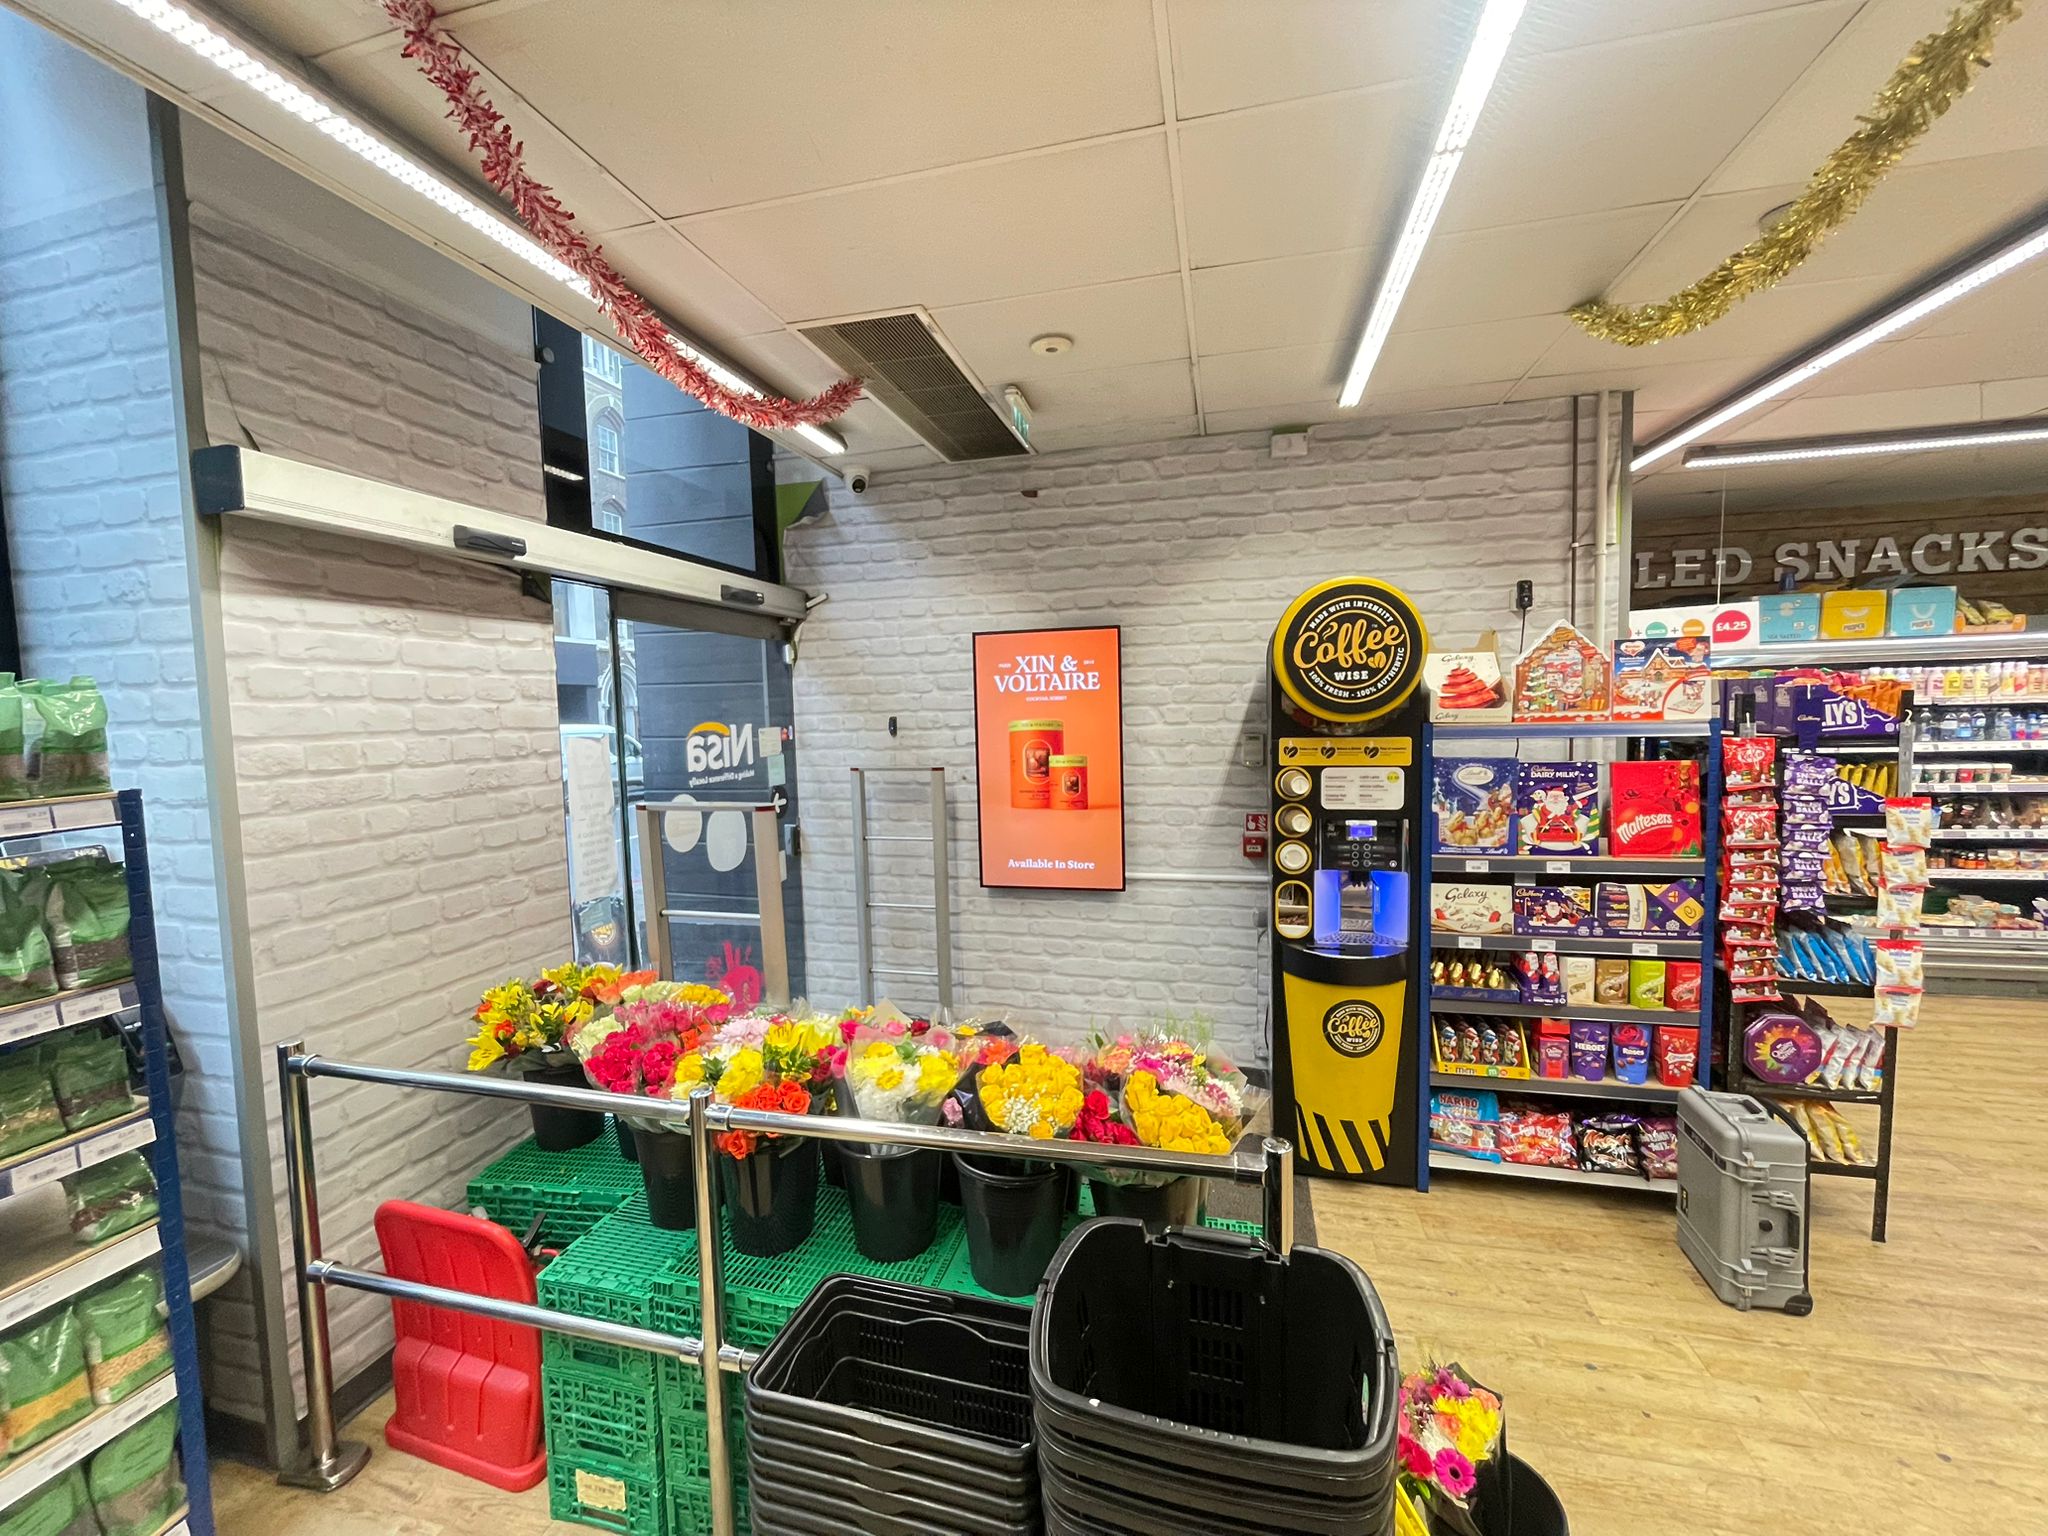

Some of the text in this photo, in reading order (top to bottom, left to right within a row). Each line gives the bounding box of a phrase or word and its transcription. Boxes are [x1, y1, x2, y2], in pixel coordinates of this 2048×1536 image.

[1774, 527, 2048, 582] SNACKS
[1309, 600, 1394, 629] MADE WITH INTENSITY
[1715, 620, 1747, 632] £4.25
[1294, 619, 1405, 669] Coffee
[1015, 655, 1078, 674] XIN &
[1309, 647, 1405, 698] 100% FRESH 100% AUTHENTIC
[994, 672, 1101, 693] VOLTAIRE
[1334, 671, 1369, 681] WISE
[1531, 765, 1555, 773] Cadbury
[1616, 813, 1673, 844] Maltesers
[1008, 858, 1095, 870] Available In Store
[1445, 888, 1488, 903] Galaxy
[1516, 888, 1543, 897] Cadbury
[1327, 1015, 1379, 1037] Coffee
[1575, 1042, 1606, 1052] HEROES
[1622, 1047, 1644, 1056] Roses
[1439, 1093, 1479, 1110] HARIBO
